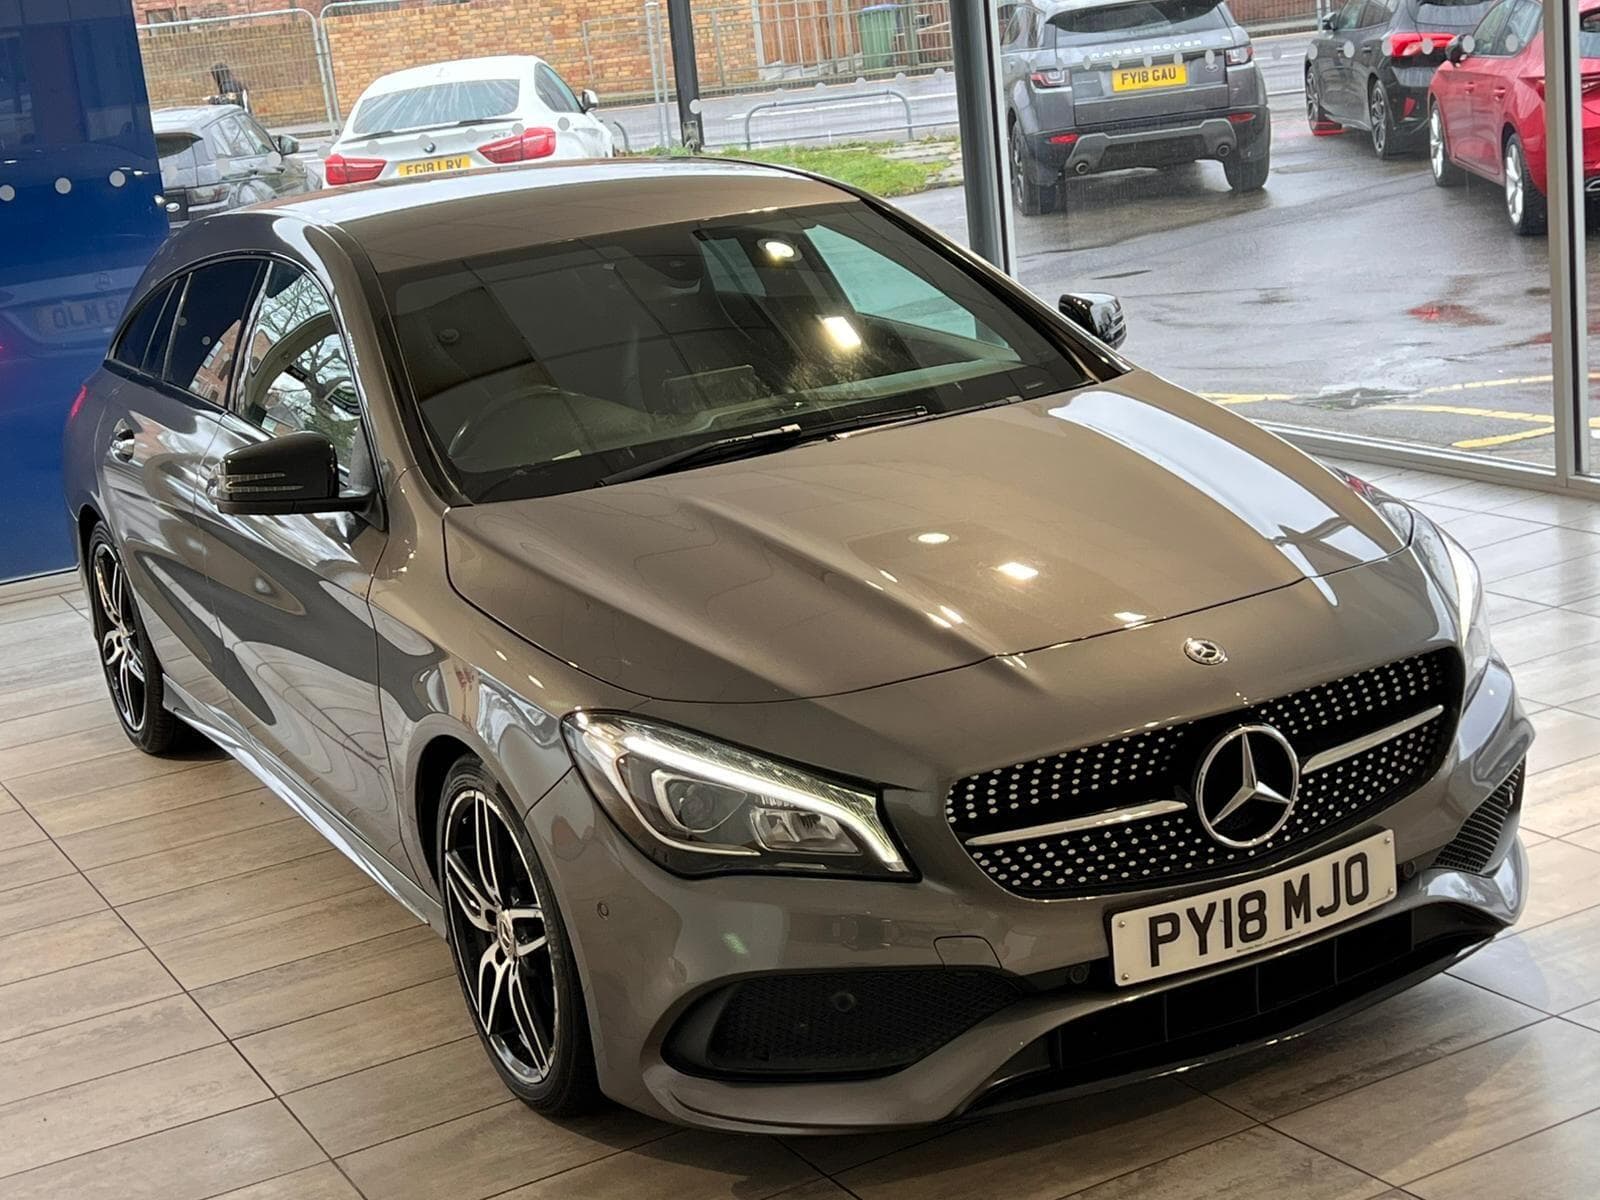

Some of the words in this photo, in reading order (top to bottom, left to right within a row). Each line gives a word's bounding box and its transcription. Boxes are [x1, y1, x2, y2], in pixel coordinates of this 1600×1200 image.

[1091, 47, 1142, 58] RANGE
[1153, 40, 1202, 51] ROVER
[1121, 70, 1149, 85] FY18
[1152, 67, 1177, 80] GAU
[1148, 889, 1267, 968] PY18
[1283, 852, 1369, 930] MJO
